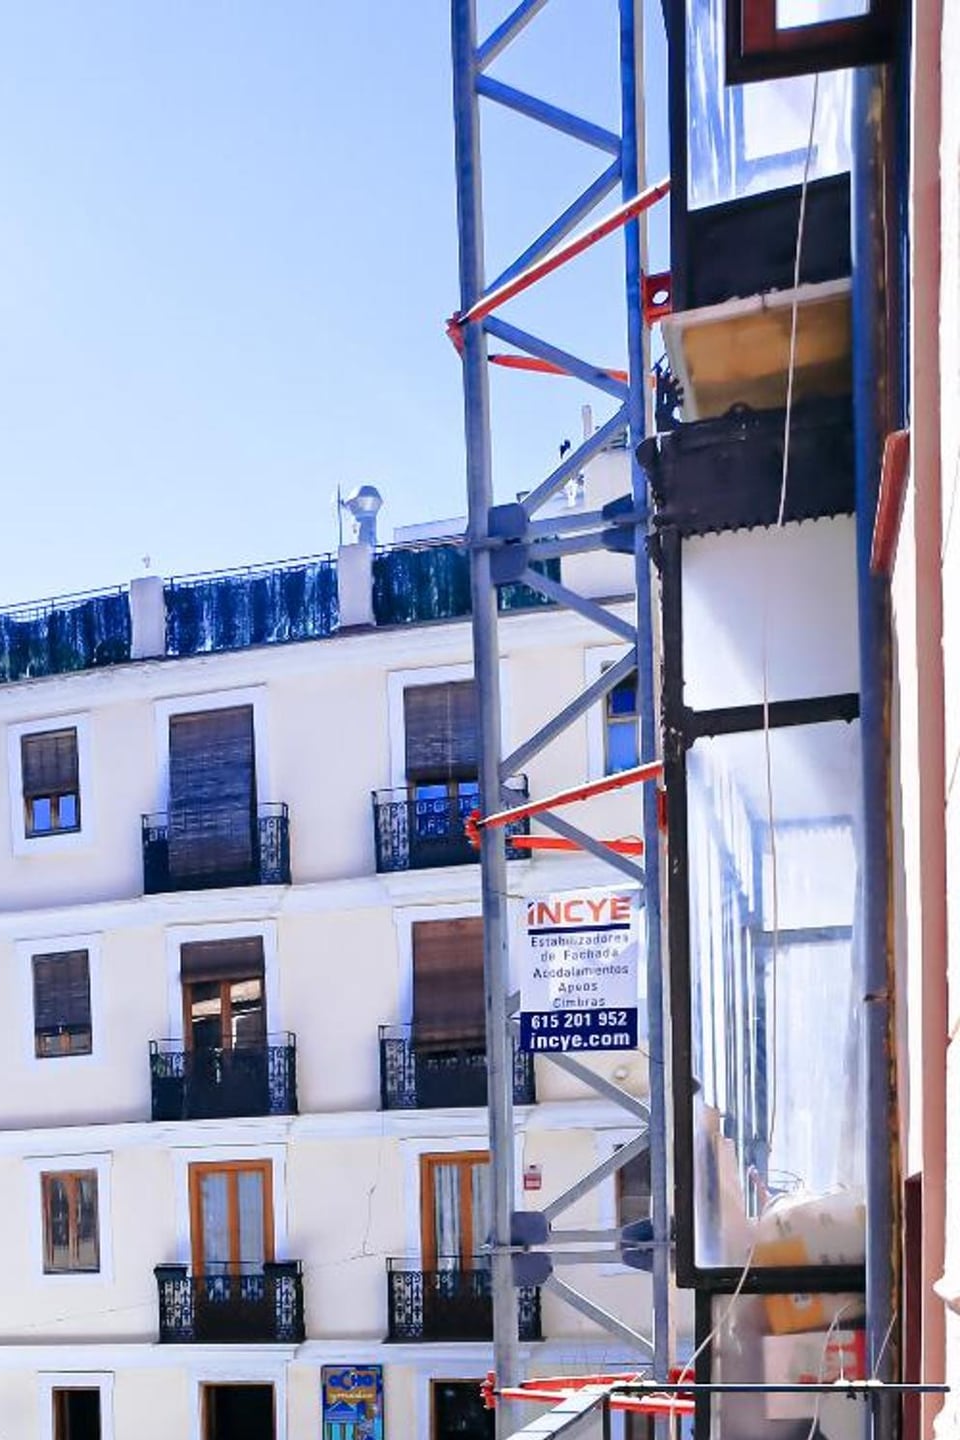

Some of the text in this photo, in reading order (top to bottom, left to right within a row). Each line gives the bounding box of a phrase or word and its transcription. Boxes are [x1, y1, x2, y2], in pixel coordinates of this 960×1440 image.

[541, 950, 556, 961] de
[531, 1011, 627, 1029] 615 201 952
[530, 1032, 630, 1051] incye.com
